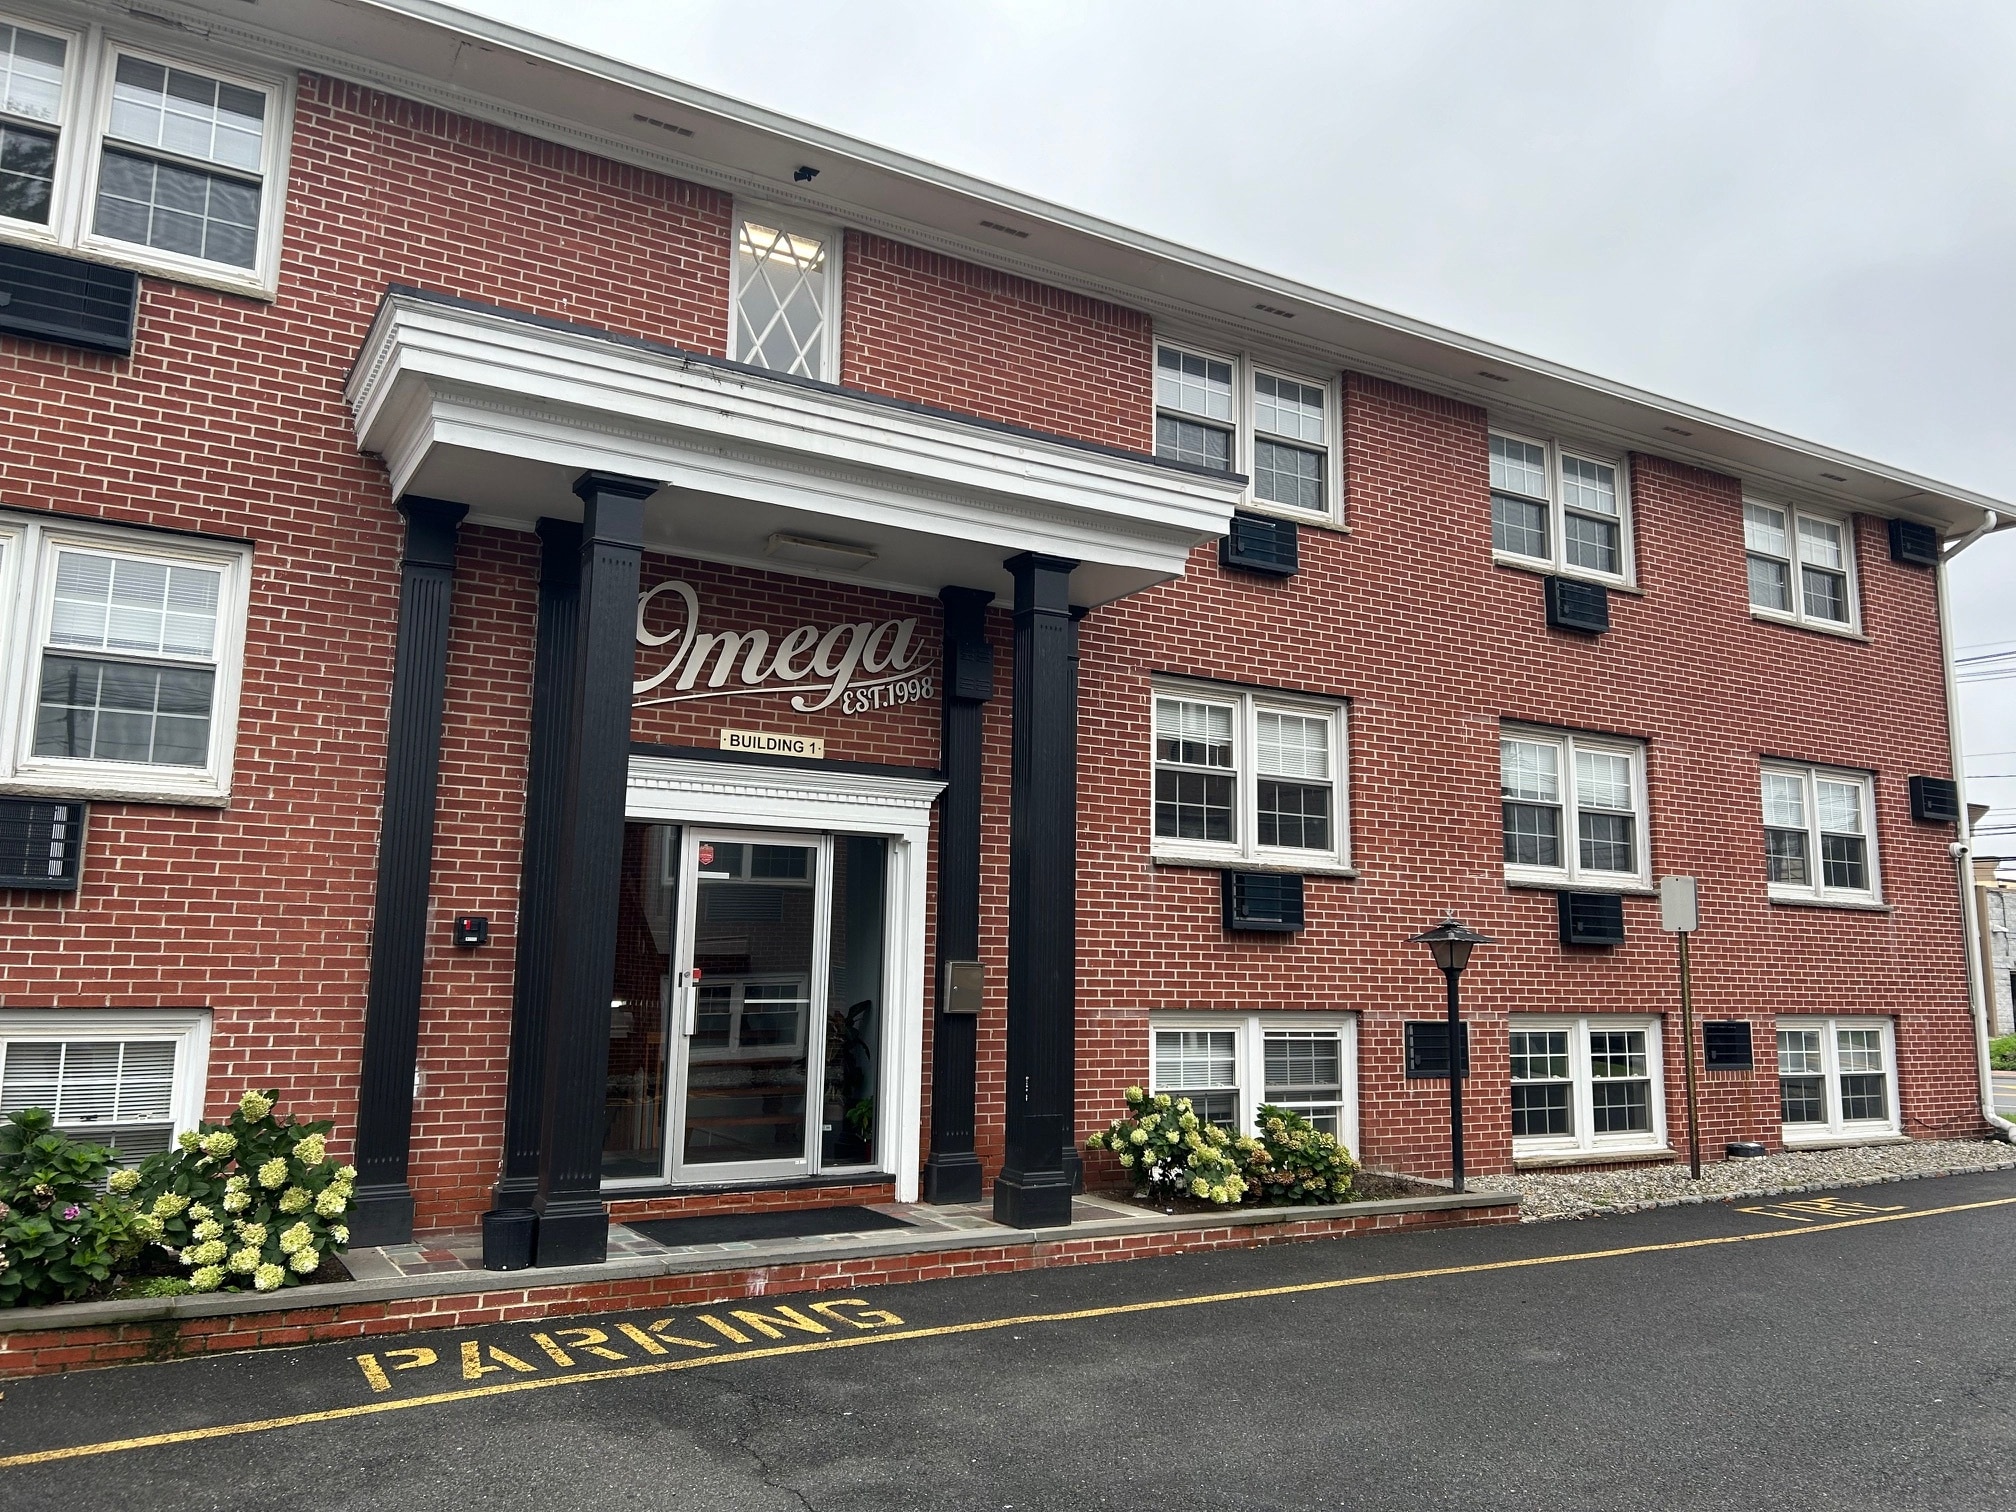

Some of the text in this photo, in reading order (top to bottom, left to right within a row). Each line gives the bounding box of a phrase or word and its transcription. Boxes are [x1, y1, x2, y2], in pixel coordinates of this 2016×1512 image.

[632, 580, 926, 712] Omega
[843, 677, 934, 715] EST.1998
[731, 734, 816, 754] BUILDING 1
[1734, 1197, 1909, 1222] FIRE
[355, 1299, 905, 1392] PARKING
